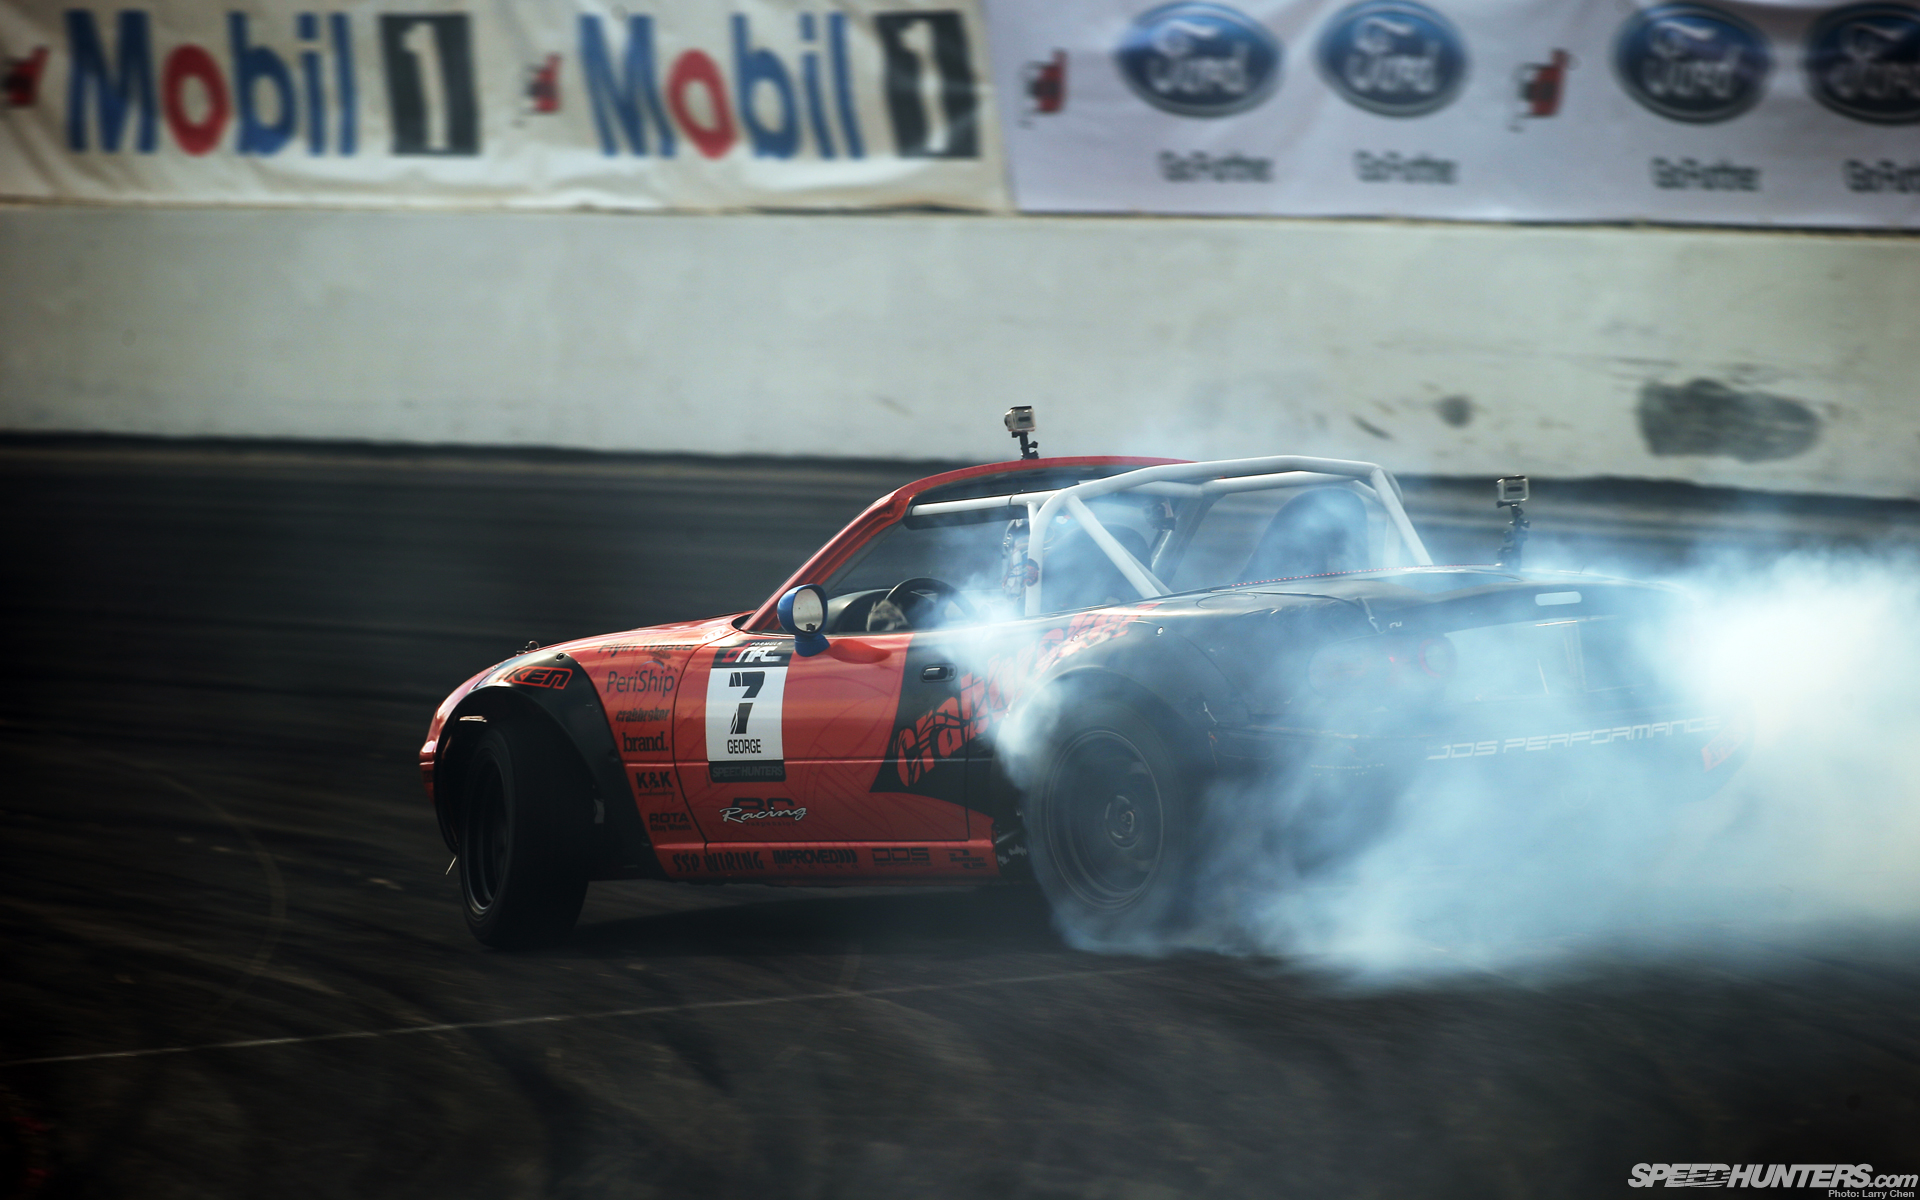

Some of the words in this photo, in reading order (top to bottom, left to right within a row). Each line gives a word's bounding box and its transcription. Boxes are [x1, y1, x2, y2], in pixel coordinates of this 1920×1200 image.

[1146, 18, 1250, 95] Ford
[1344, 16, 1441, 94] Ford
[1640, 20, 1744, 98] Ford
[65, 9, 358, 157] Mobil
[577, 12, 866, 160] Mobil
[606, 670, 675, 697] PeriShip
[729, 671, 766, 735] 7
[622, 732, 669, 752] brand.
[727, 739, 762, 754] GEORGE
[1503, 715, 1721, 754] PERFORMANCE
[636, 771, 673, 788] K&K
[712, 766, 784, 777] SPEEDHUNTERS
[649, 813, 689, 823] ROTA
[719, 806, 808, 824] Racing
[703, 851, 765, 873] WIRING
